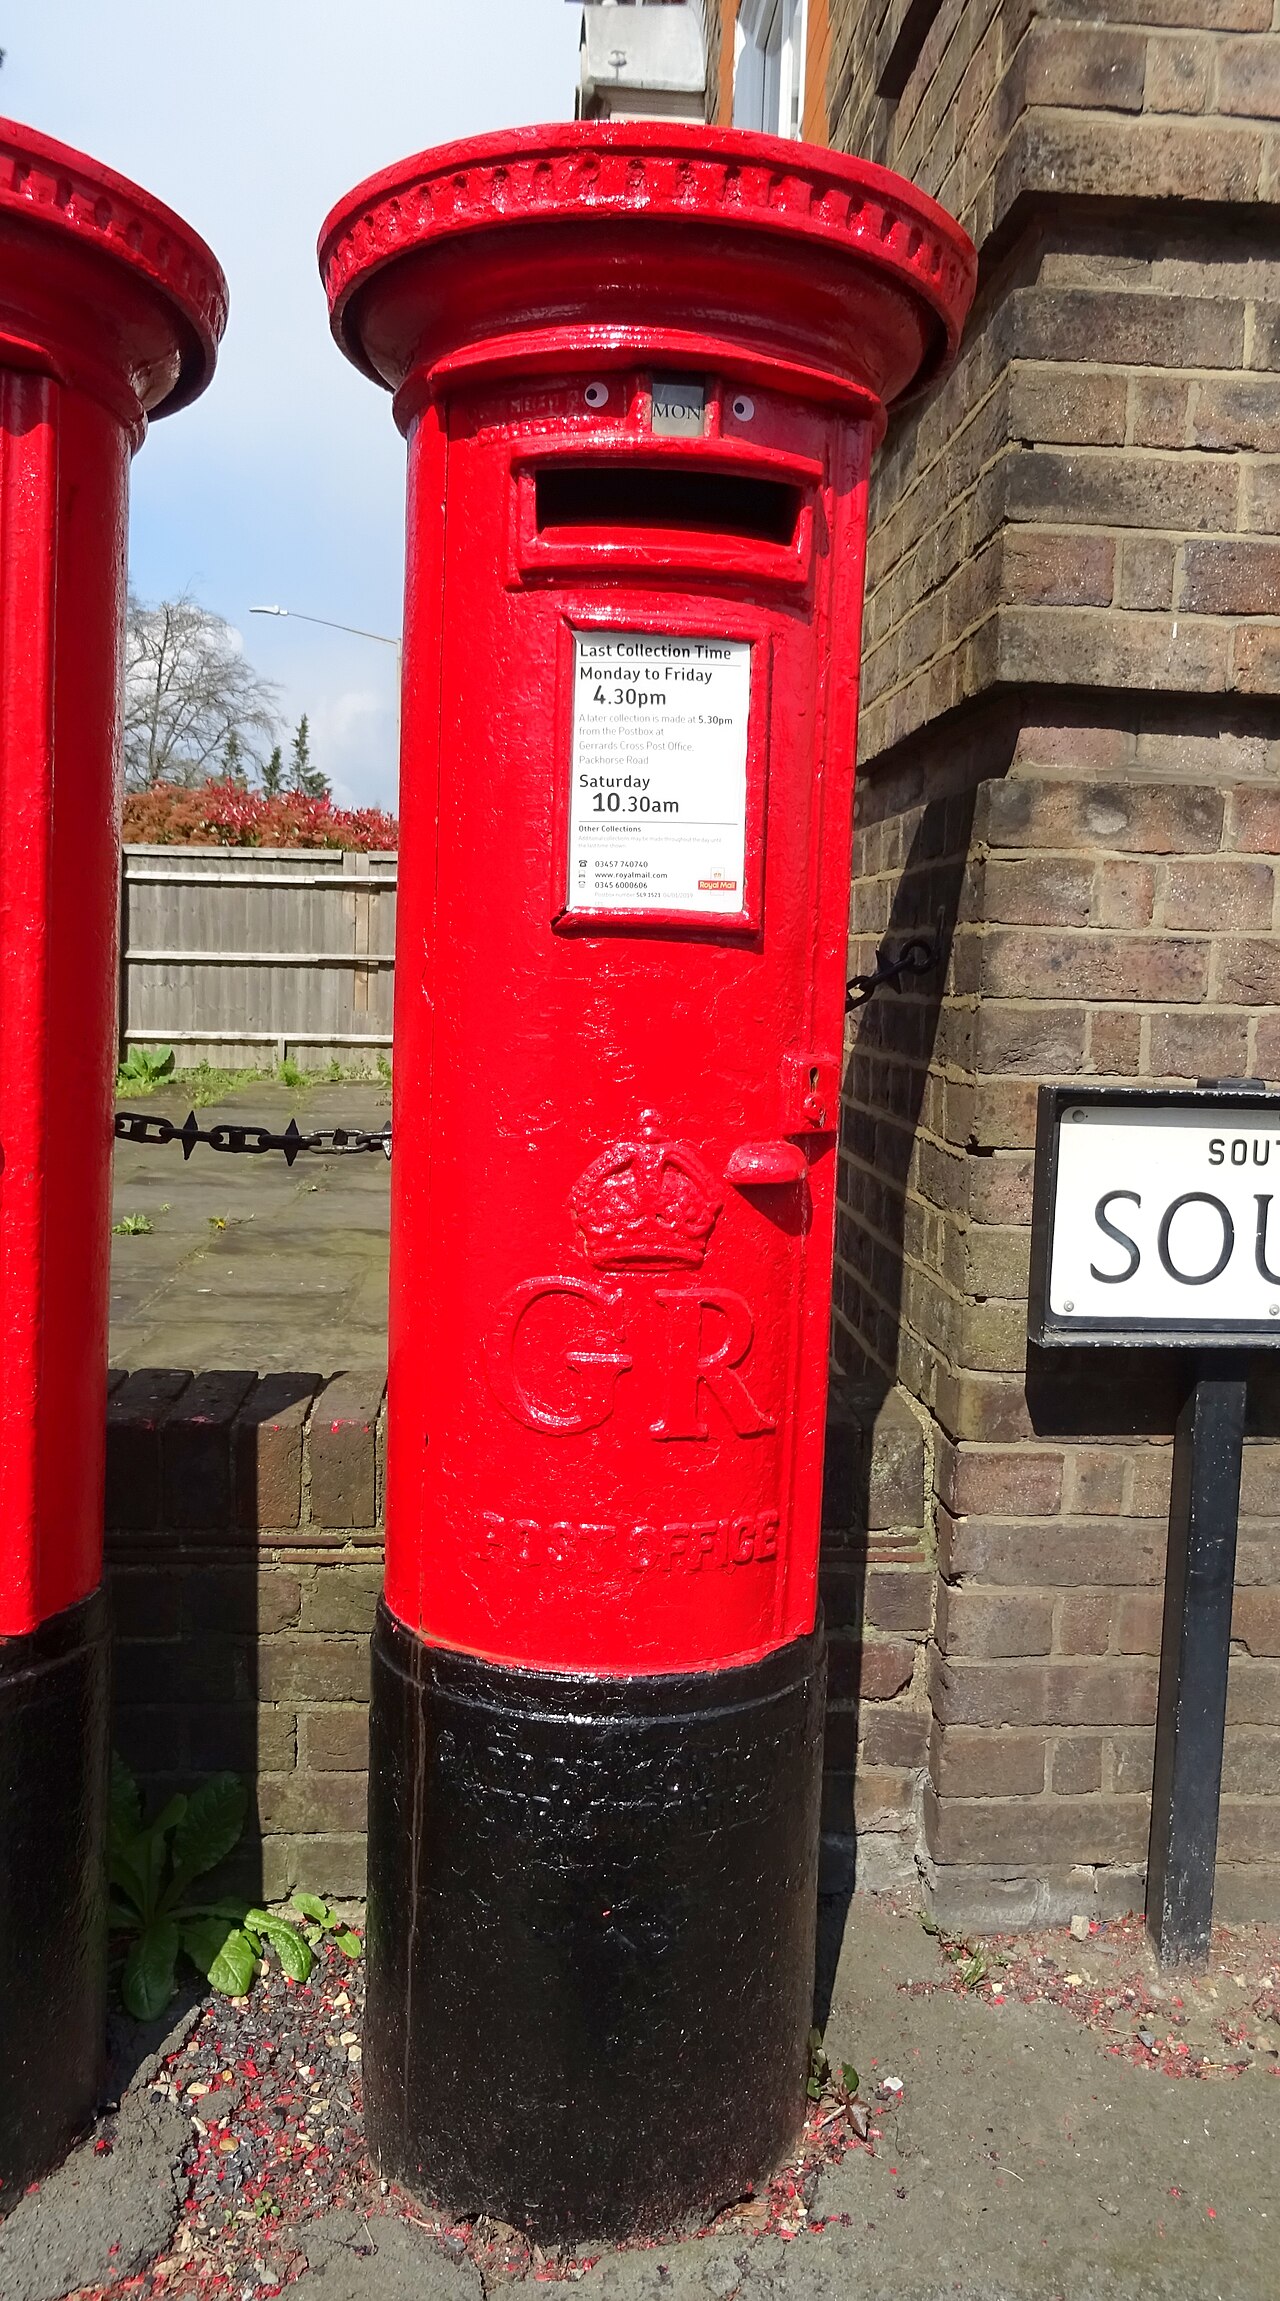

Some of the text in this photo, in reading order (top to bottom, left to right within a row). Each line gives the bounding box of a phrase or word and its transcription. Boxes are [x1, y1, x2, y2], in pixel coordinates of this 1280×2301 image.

[653, 402, 703, 421] MON
[580, 643, 731, 660] Last Collection Time
[580, 667, 712, 684] Monday to Friday
[593, 685, 666, 708] 4.30pm
[579, 714, 733, 726] A later collection is made at 5.30pm
[579, 727, 664, 736] from the Postbox at
[579, 741, 618, 751] Gerrards
[620, 741, 645, 751] Cross
[646, 741, 666, 751] Post
[579, 755, 649, 765] Packhorse Road
[579, 774, 650, 790] Saturday
[592, 793, 679, 813] 10.30am
[601, 825, 642, 833] Collections
[594, 871, 668, 879] www.royalmail.com
[699, 881, 736, 890] Royal Mail
[1208, 1138, 1280, 1166] SOU
[476, 1508, 781, 1576] POST OFFICE
